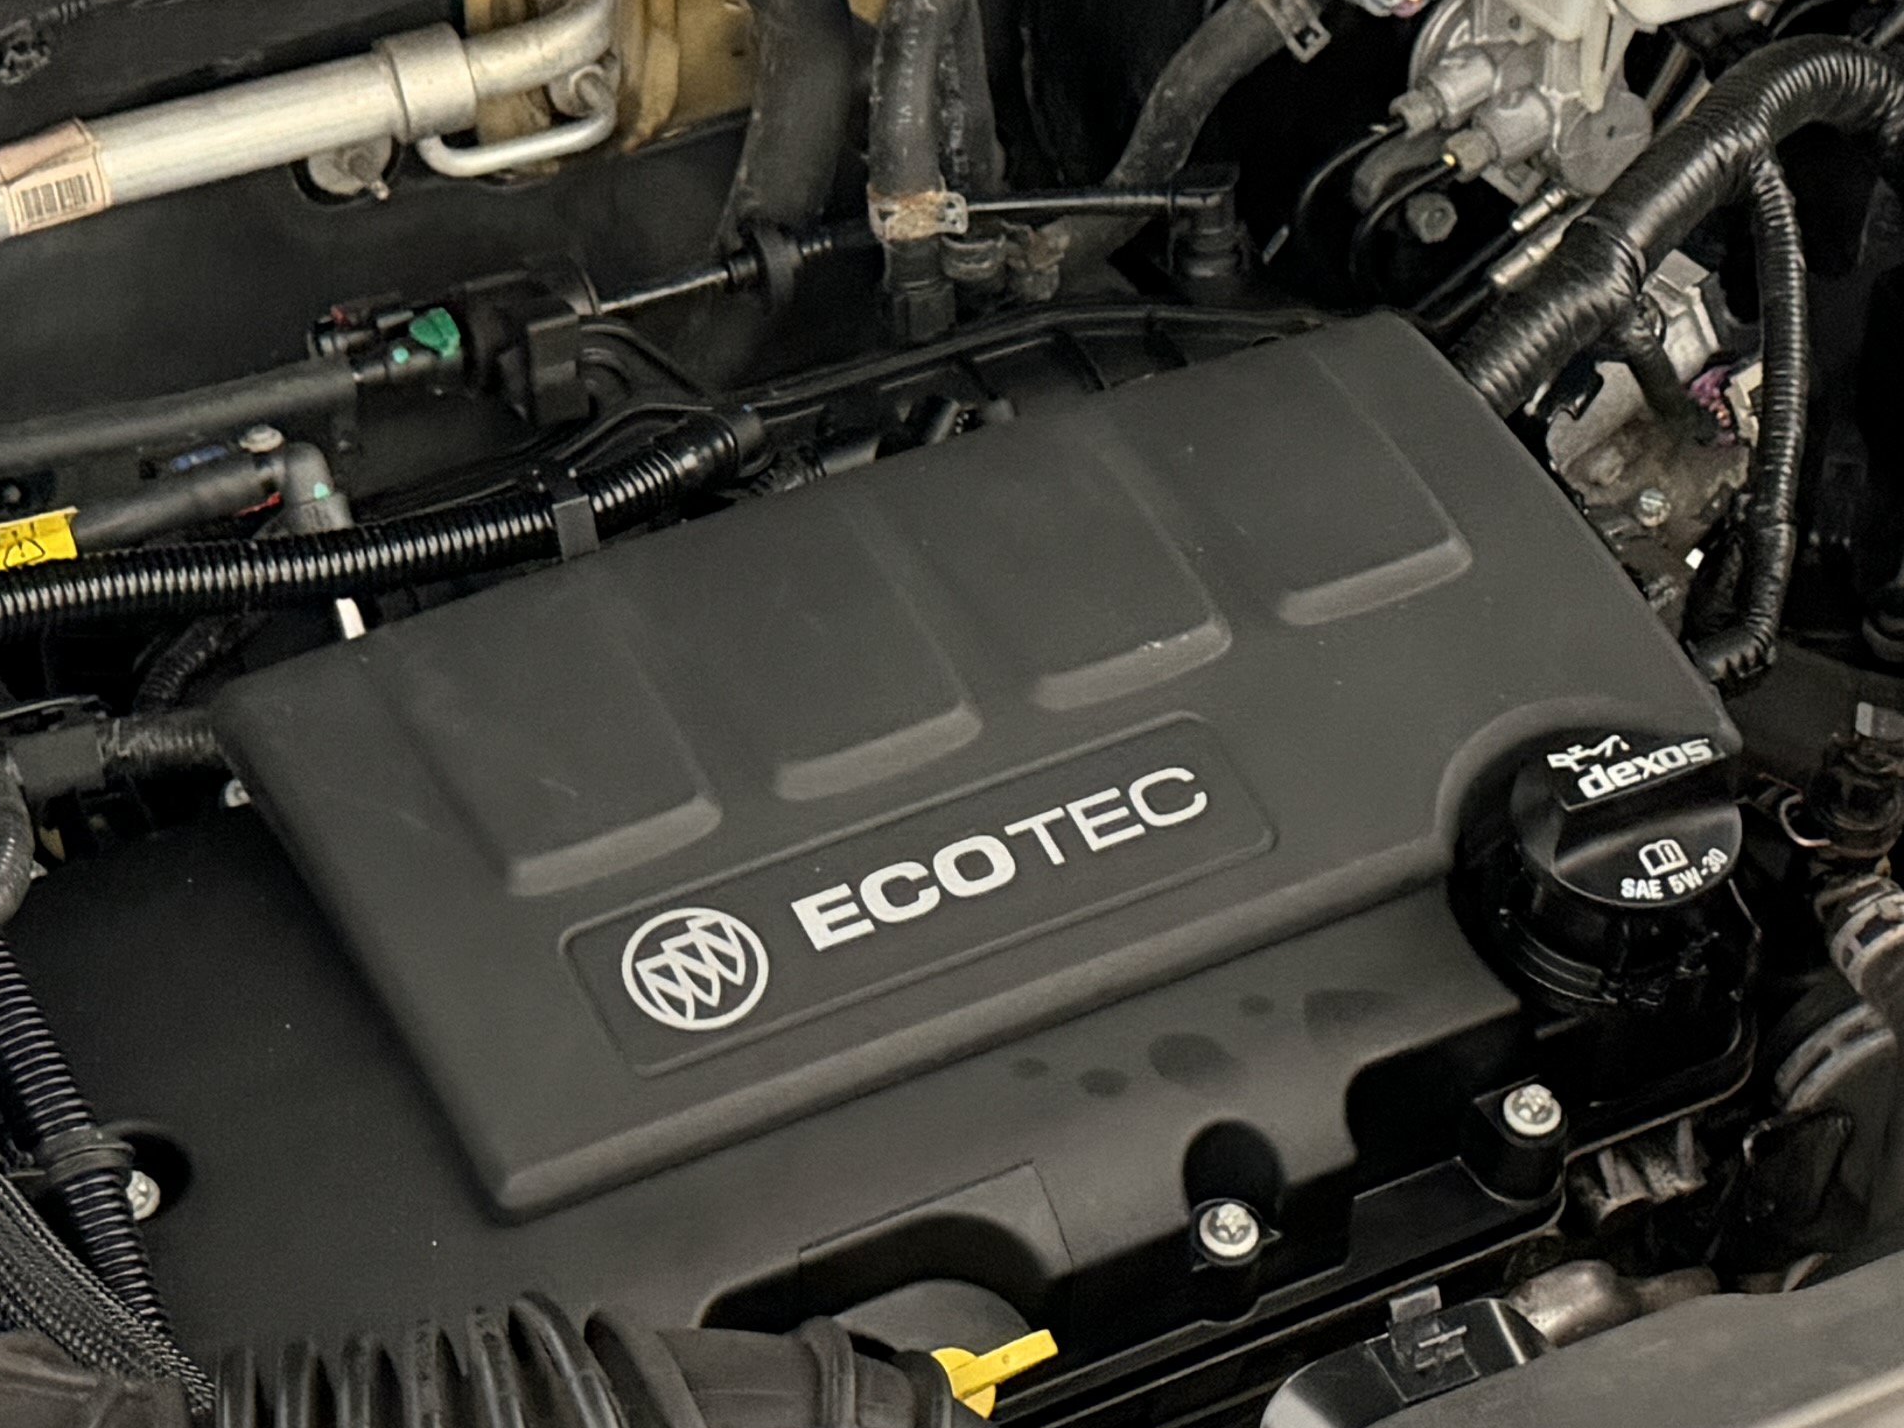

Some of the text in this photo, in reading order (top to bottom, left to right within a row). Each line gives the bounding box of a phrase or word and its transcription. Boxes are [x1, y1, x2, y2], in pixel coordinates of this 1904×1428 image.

[1577, 739, 1712, 798] dexos
[792, 766, 1208, 951] ECOTEC
[1620, 847, 1728, 900] SAE 5W-30
